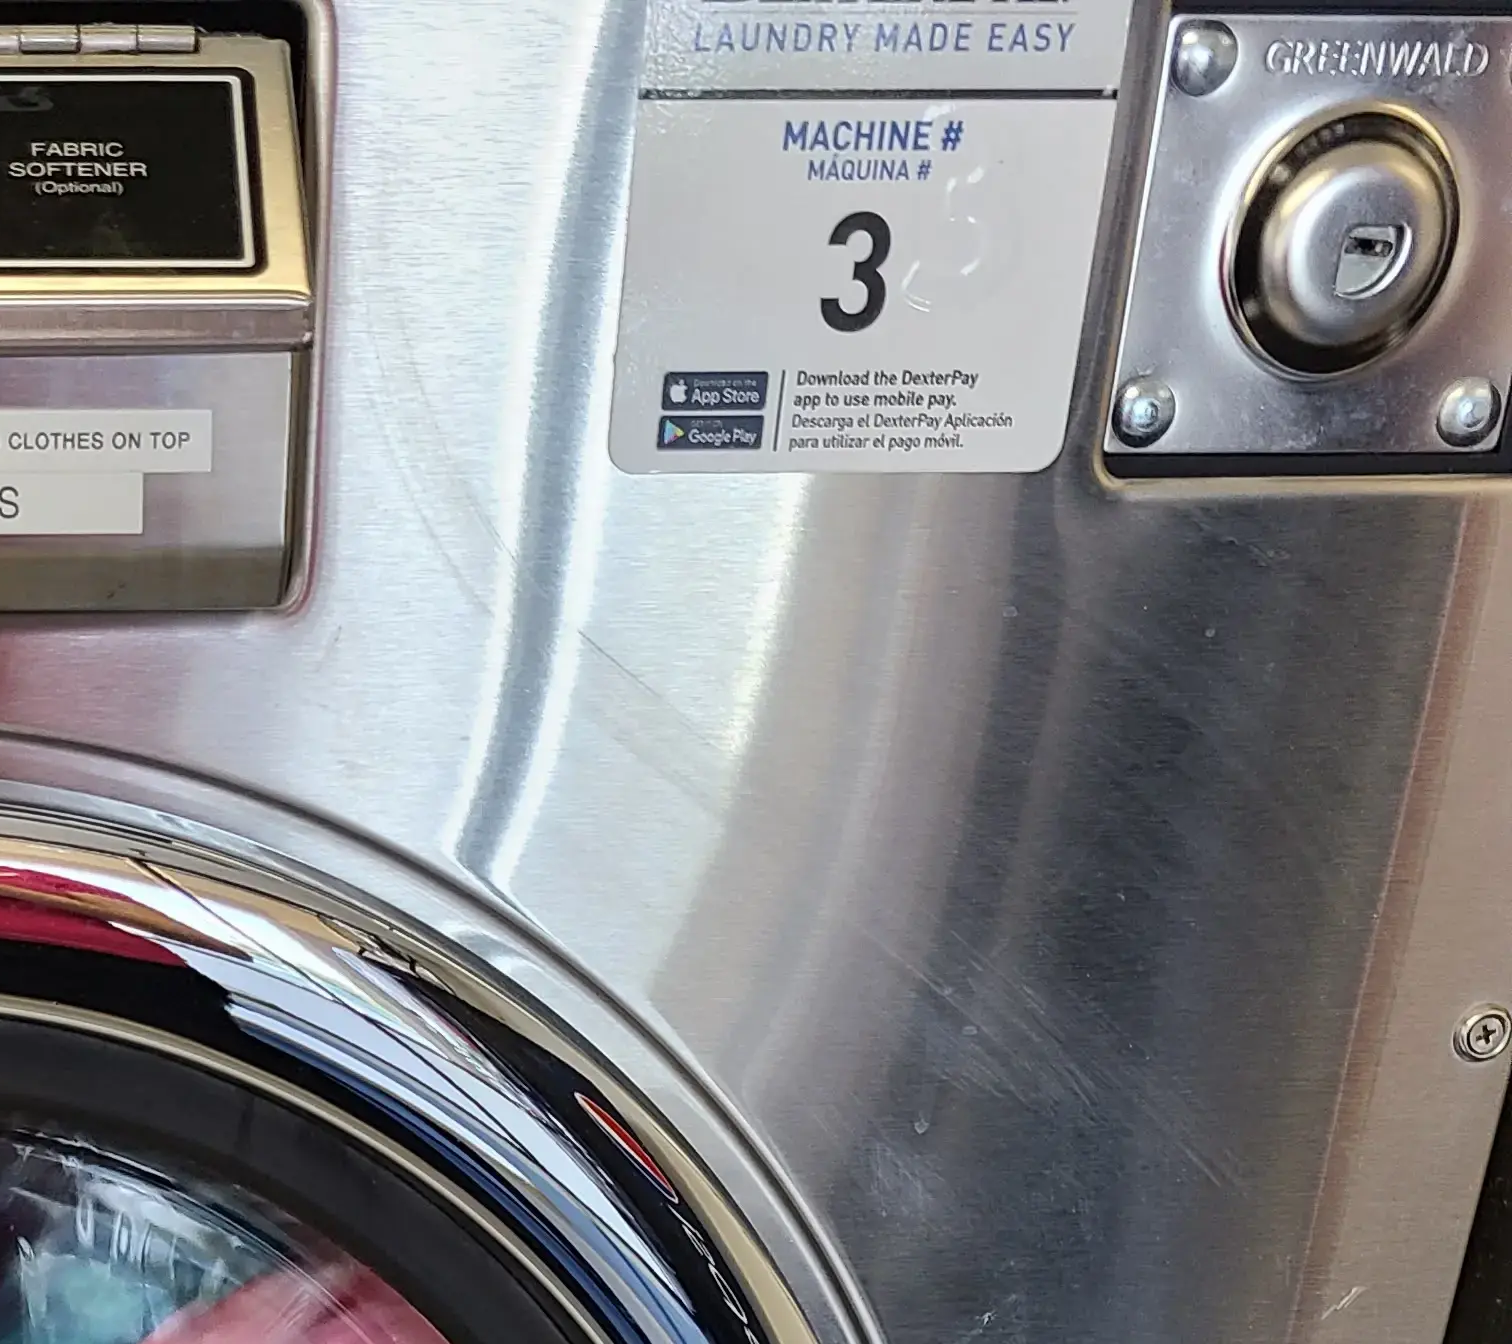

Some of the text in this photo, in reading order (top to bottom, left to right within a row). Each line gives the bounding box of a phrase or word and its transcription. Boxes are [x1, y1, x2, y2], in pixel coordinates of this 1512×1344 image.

[692, 22, 1077, 52] LAUNDRY MADE EASY
[1265, 39, 1490, 77] GREENWALD
[782, 120, 964, 151] MACHINE #
[30, 142, 125, 157] FABRIC
[8, 162, 148, 177] SOFTENER
[807, 154, 933, 181] MÁQUINA #
[35, 180, 124, 196] (Optional)
[819, 210, 892, 333] 3
[796, 369, 979, 389] Download the DexterPay
[691, 387, 760, 406] App Store
[792, 390, 957, 411] app to use mobile pay.
[791, 412, 1013, 432] Descarga el DexterPay Aplicación
[7, 432, 105, 450] CLOTHES
[111, 432, 141, 450] ON
[150, 431, 191, 450] TOP
[688, 427, 758, 446] Google Play
[788, 432, 964, 453] para utilizar el pago móvil.
